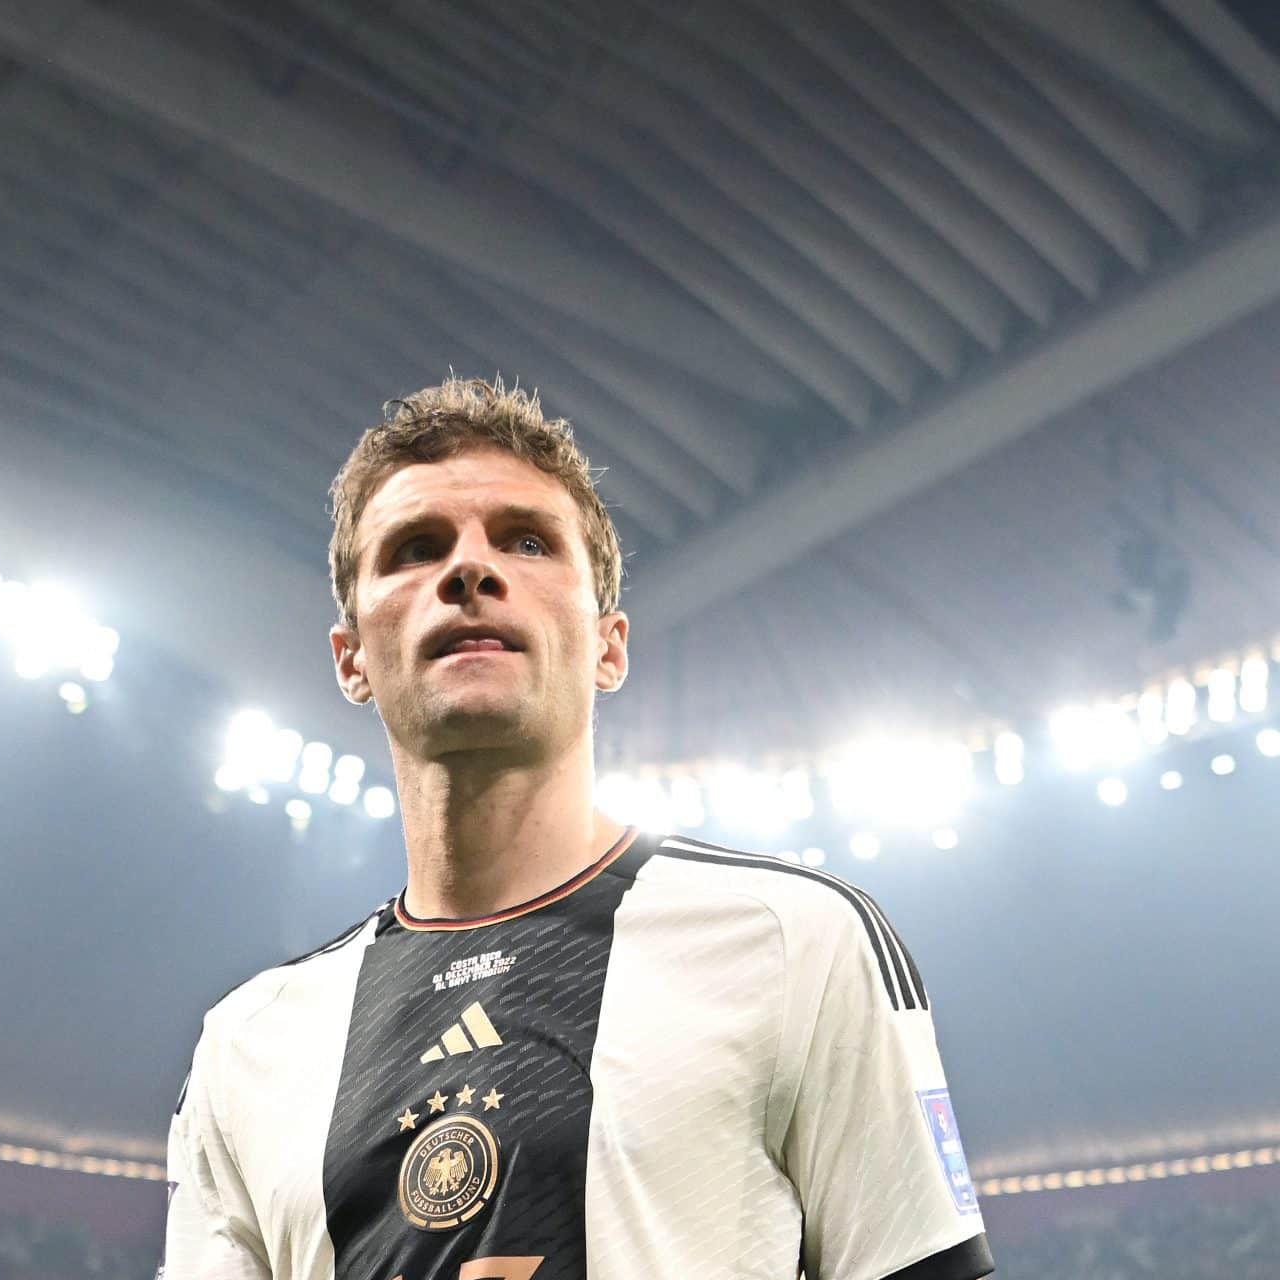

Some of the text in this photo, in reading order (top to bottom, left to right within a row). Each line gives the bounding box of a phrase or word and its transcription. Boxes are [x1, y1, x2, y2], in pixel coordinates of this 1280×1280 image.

[445, 962, 491, 981] DECEMBER
[493, 956, 517, 967] 2022
[450, 950, 502, 971] COSTA RICA
[435, 966, 511, 991] AL BAYT STADIUM
[420, 1131, 474, 1158] DEUTSCHER
[411, 1176, 480, 1214] FUSSBALL-BUND
